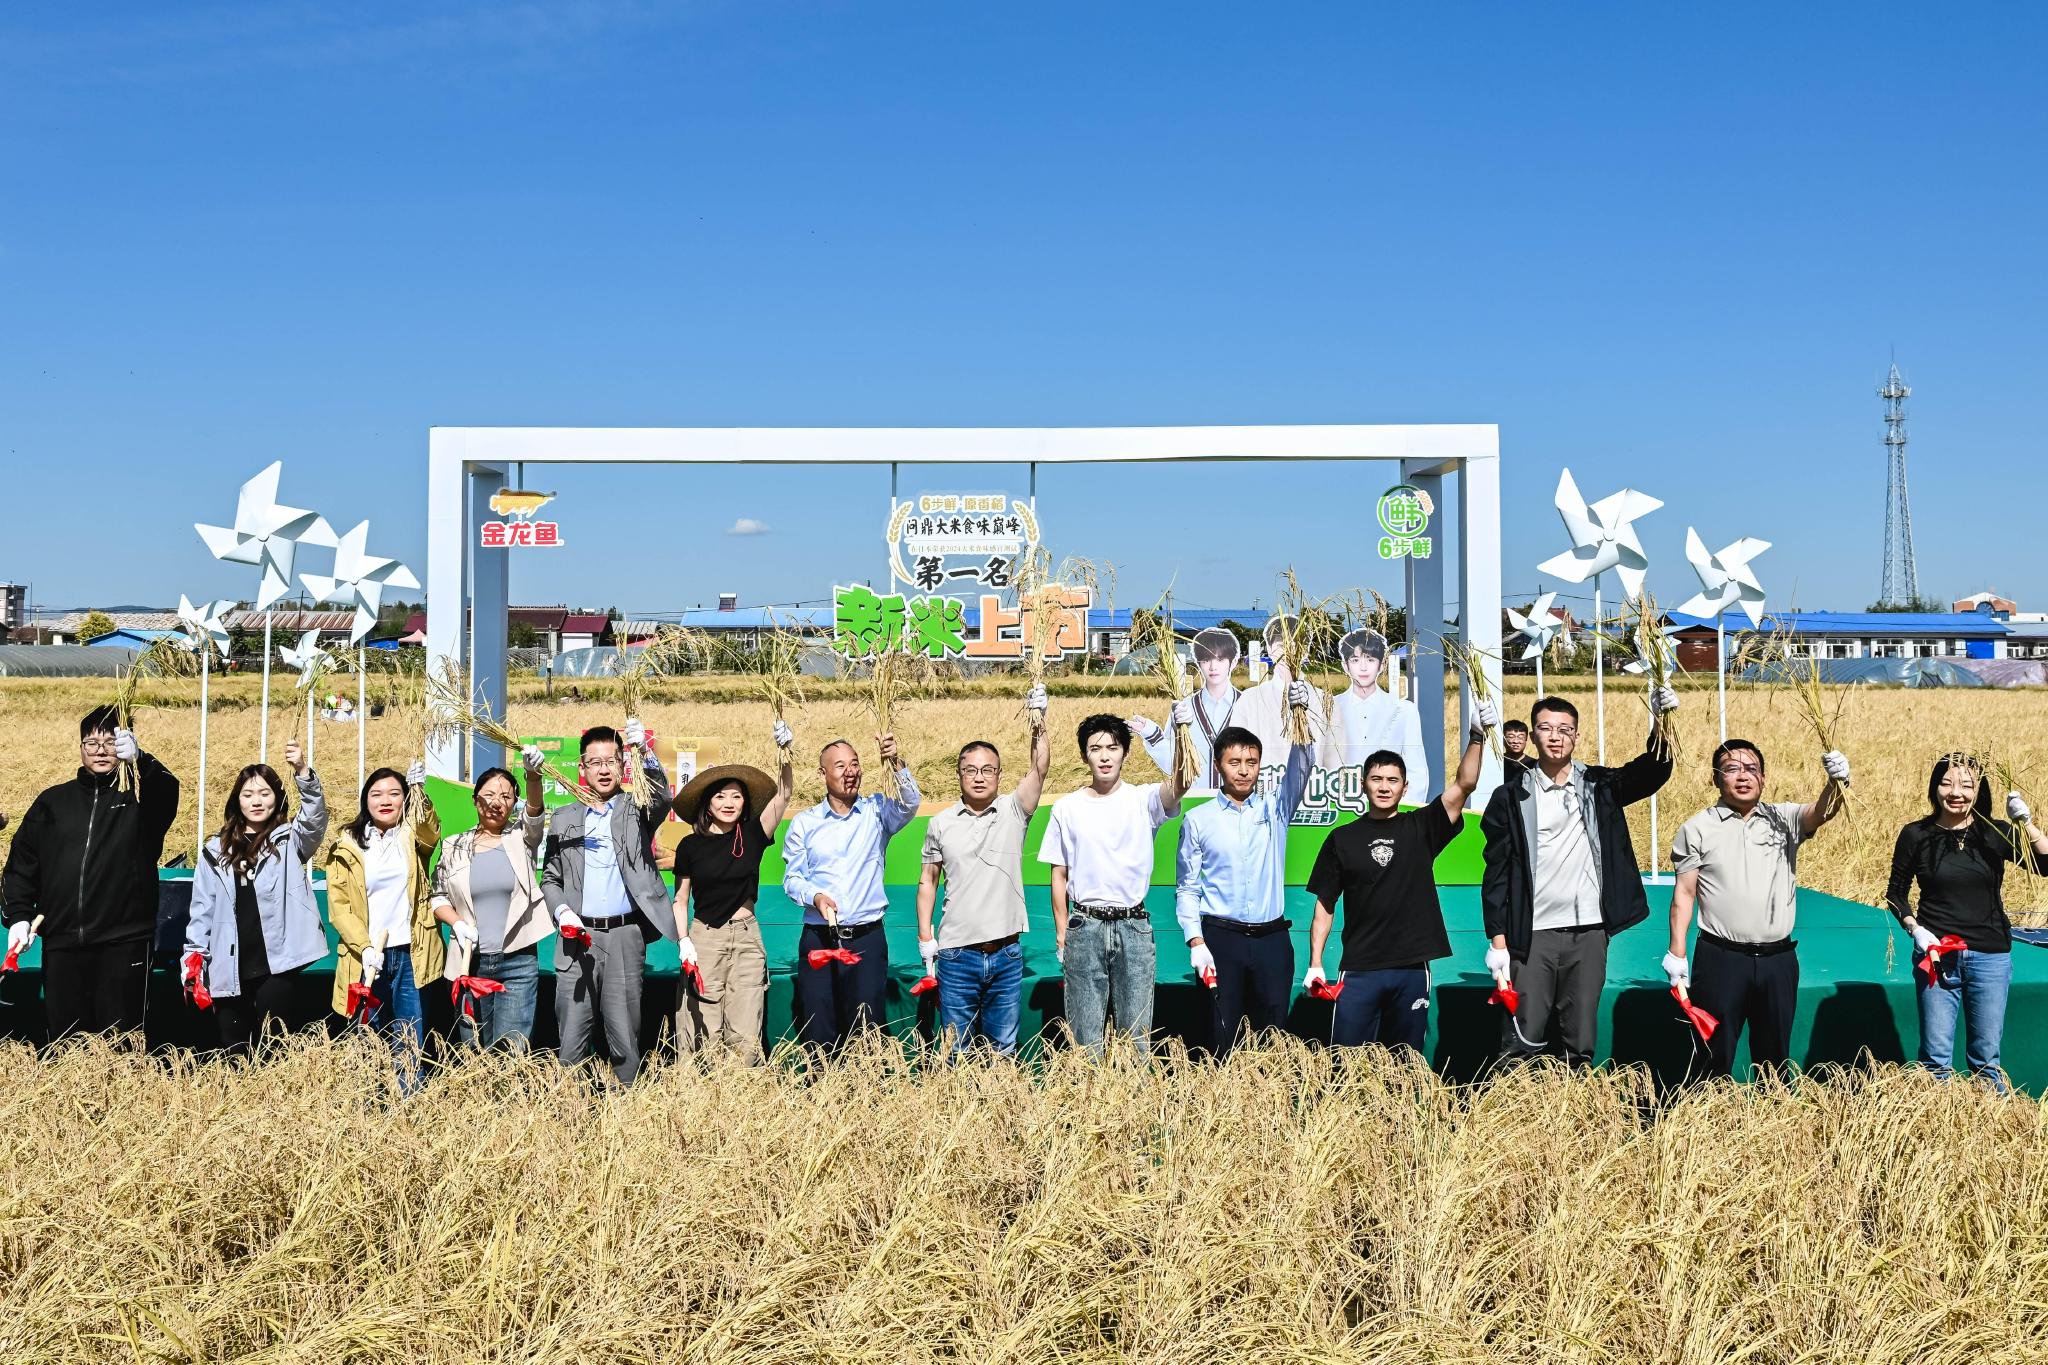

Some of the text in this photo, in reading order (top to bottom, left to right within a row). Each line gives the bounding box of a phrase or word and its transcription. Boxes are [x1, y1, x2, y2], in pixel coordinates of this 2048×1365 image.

[1388, 497, 1419, 527] 鲜
[482, 522, 559, 546] 金龙鱼
[906, 516, 1021, 536] 问鼎大米食味巅峰
[1379, 537, 1432, 558] 6步鲜
[915, 555, 1009, 592] 第一名
[832, 586, 1091, 659] 新米上市
